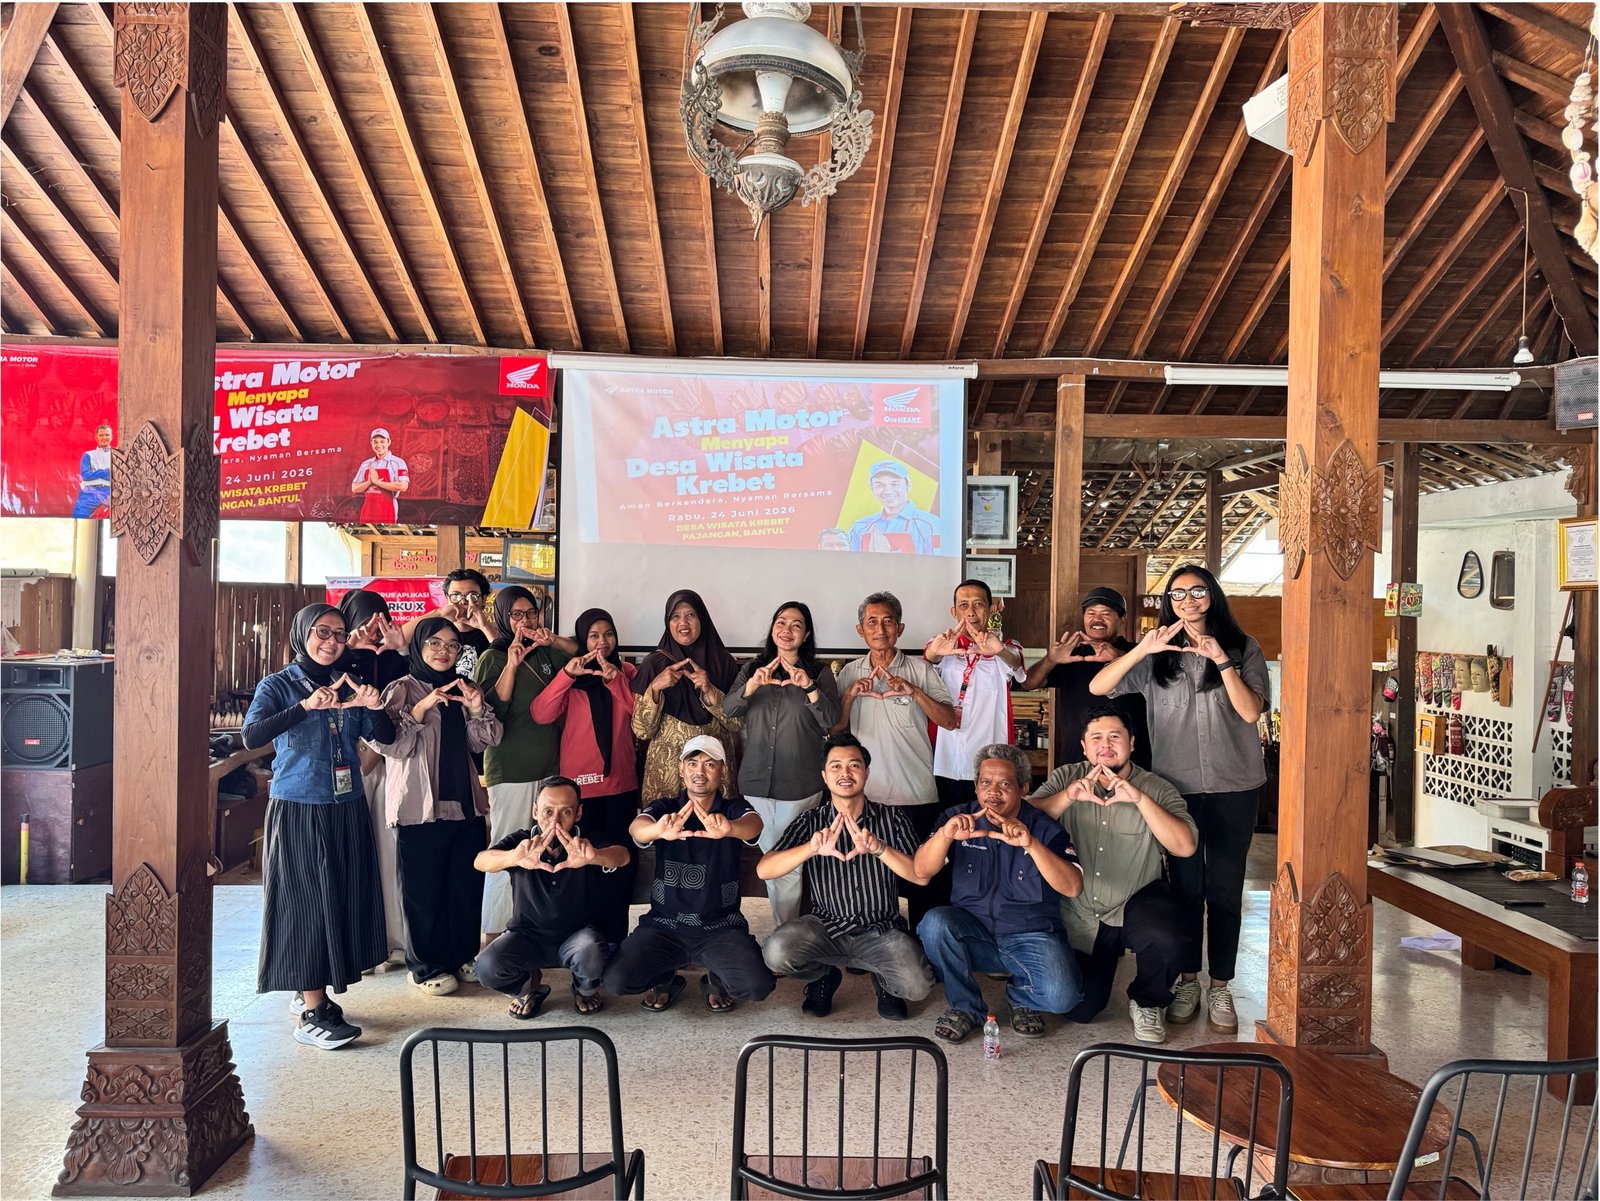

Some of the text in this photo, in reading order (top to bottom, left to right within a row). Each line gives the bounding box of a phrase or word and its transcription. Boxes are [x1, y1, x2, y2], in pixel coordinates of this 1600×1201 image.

[215, 360, 362, 391] tra Motor
[227, 387, 309, 407] Menyapa
[646, 387, 673, 395] MOTOR
[229, 403, 319, 429] Wisata
[652, 408, 844, 439] Astra Motor
[701, 435, 789, 451] Menyapa
[250, 452, 291, 462] Nyaman
[296, 447, 342, 457] Bersama
[625, 450, 803, 478] Desa Wisata
[225, 467, 313, 485] 24 Juni 2026
[676, 472, 775, 496] Krebet
[220, 481, 308, 498] WISATA KREBET
[220, 494, 301, 511] NGAN, BANTUL
[619, 490, 832, 511] Aman Berkendara, Nyaman Bersama
[668, 506, 796, 522] Rabu, 24 Juni 2026
[676, 517, 791, 531] DESA WISATA KREBET
[682, 527, 785, 540] PAJANGAN, BANTUL
[415, 602, 425, 611] X
